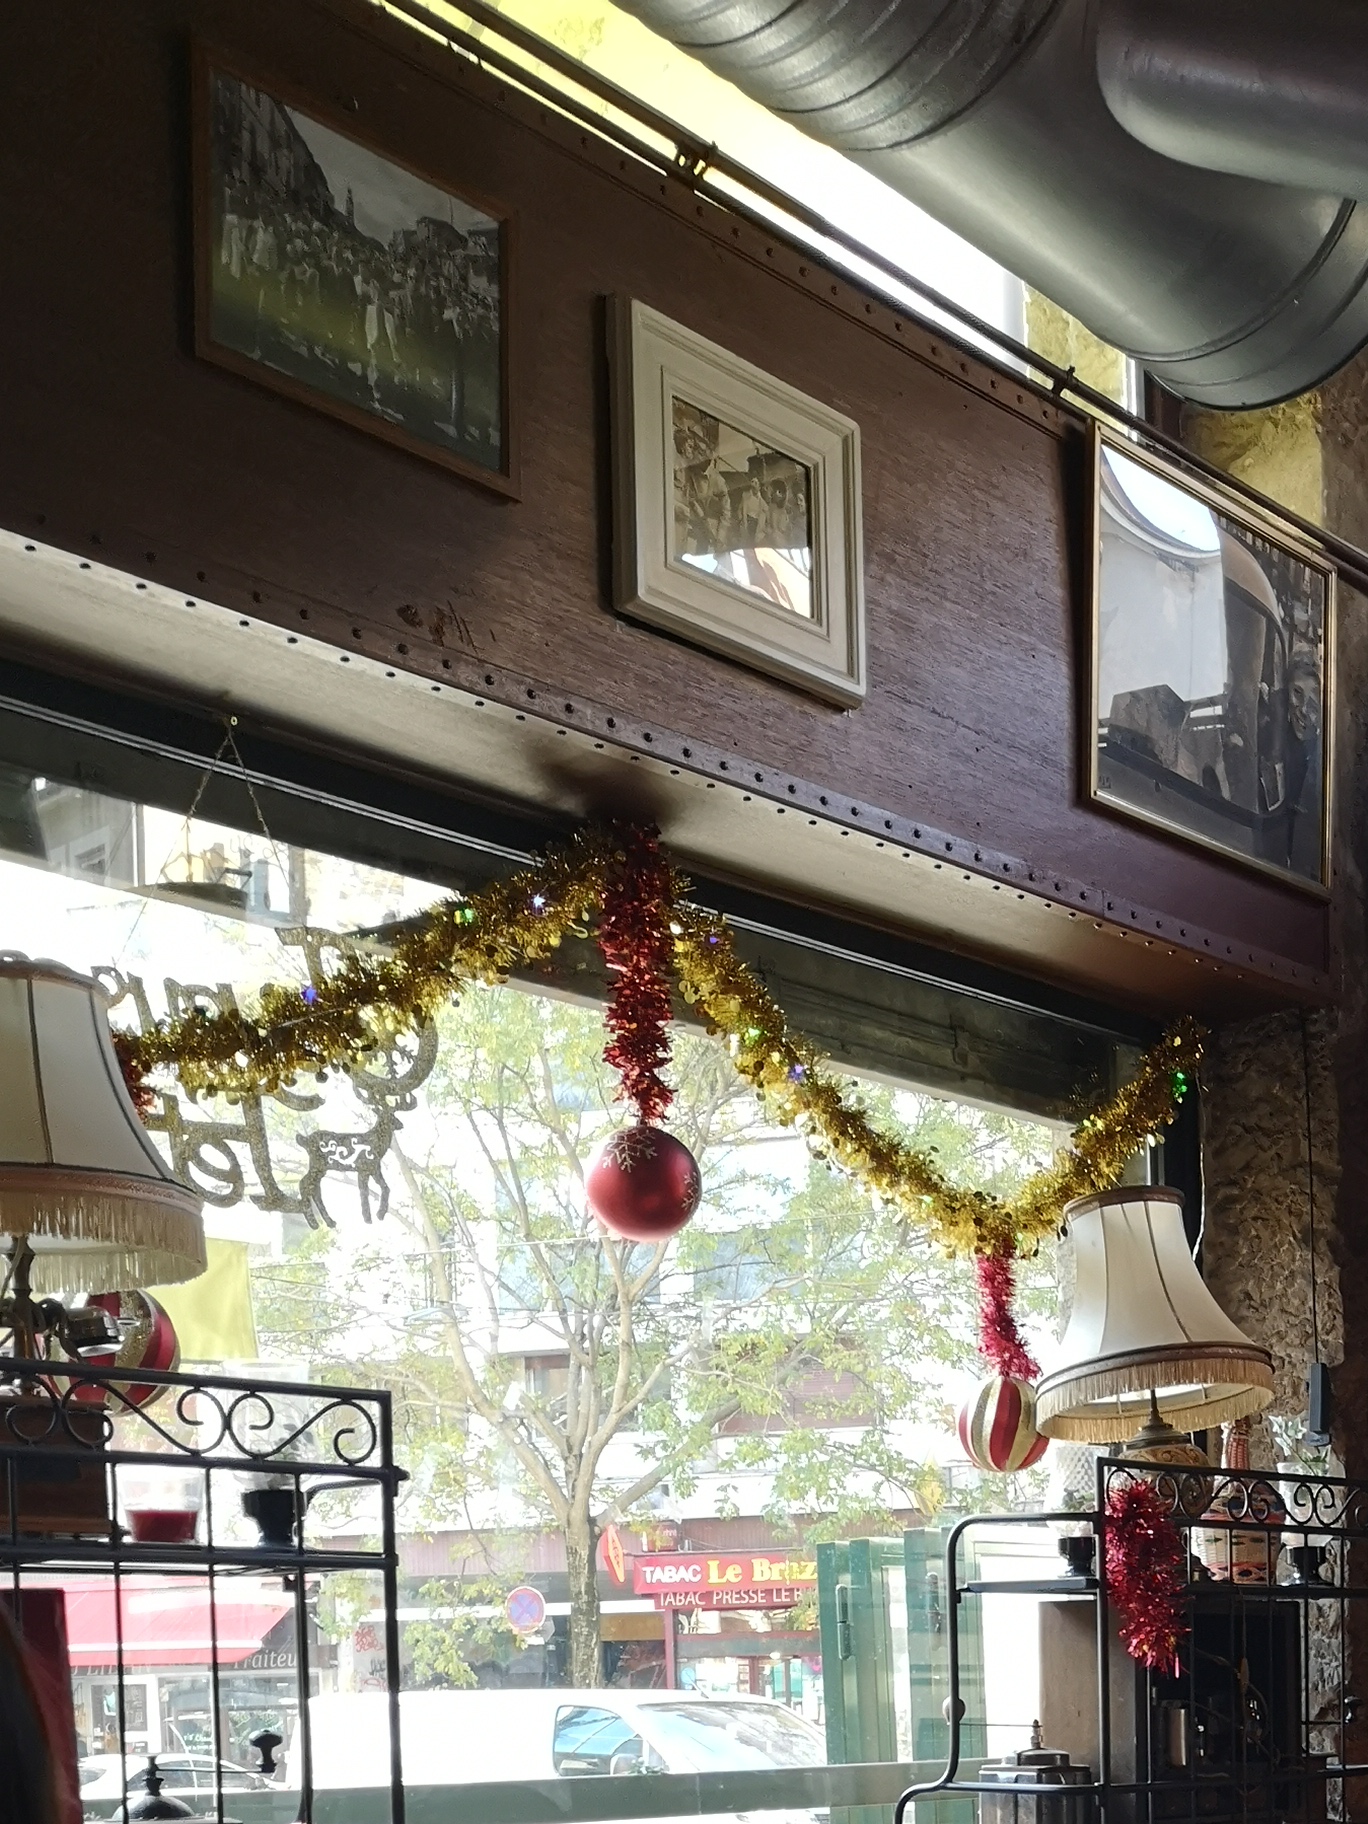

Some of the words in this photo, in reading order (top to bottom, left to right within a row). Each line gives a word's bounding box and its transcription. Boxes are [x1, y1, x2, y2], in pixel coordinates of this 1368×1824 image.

[641, 1564, 702, 1584] TABAC
[707, 1559, 743, 1584] Le
[660, 1590, 706, 1607] TABAC
[713, 1588, 767, 1605] PRESSE
[773, 1588, 791, 1603] LE
